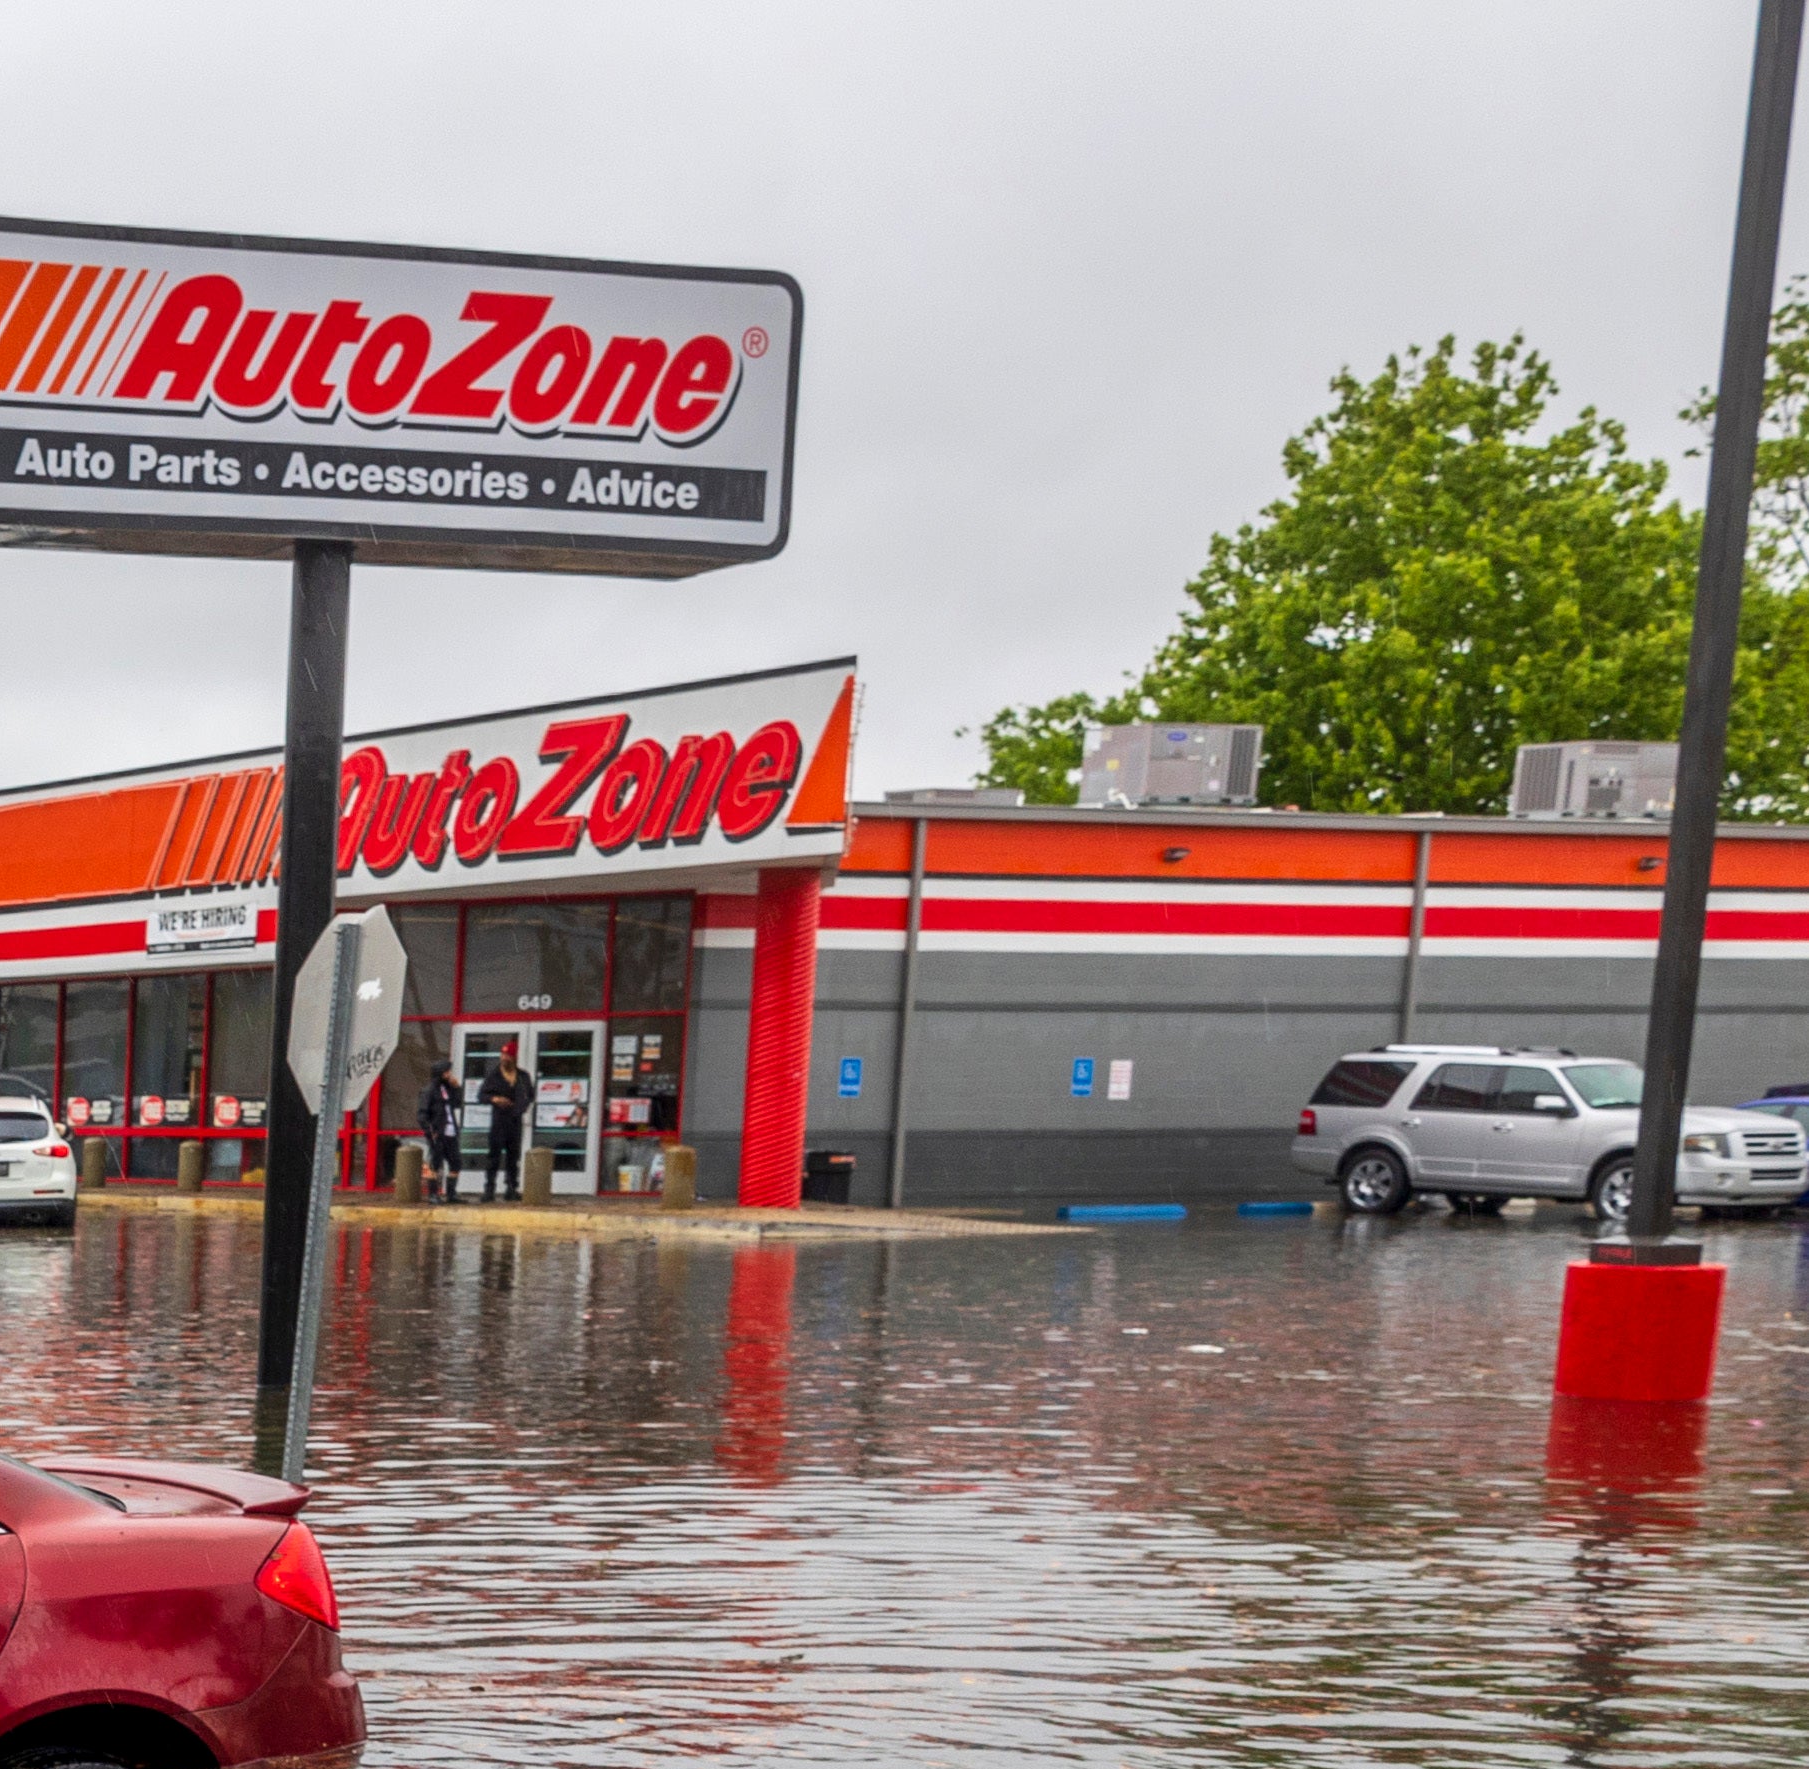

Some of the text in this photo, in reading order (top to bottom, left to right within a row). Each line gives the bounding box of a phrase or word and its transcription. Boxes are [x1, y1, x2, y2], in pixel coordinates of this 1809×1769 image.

[114, 274, 733, 434] AutoZone
[15, 437, 700, 510] Auto Parts Accessories Advice
[158, 904, 247, 931] WE'RE HIRING
[517, 994, 553, 1010] 649
